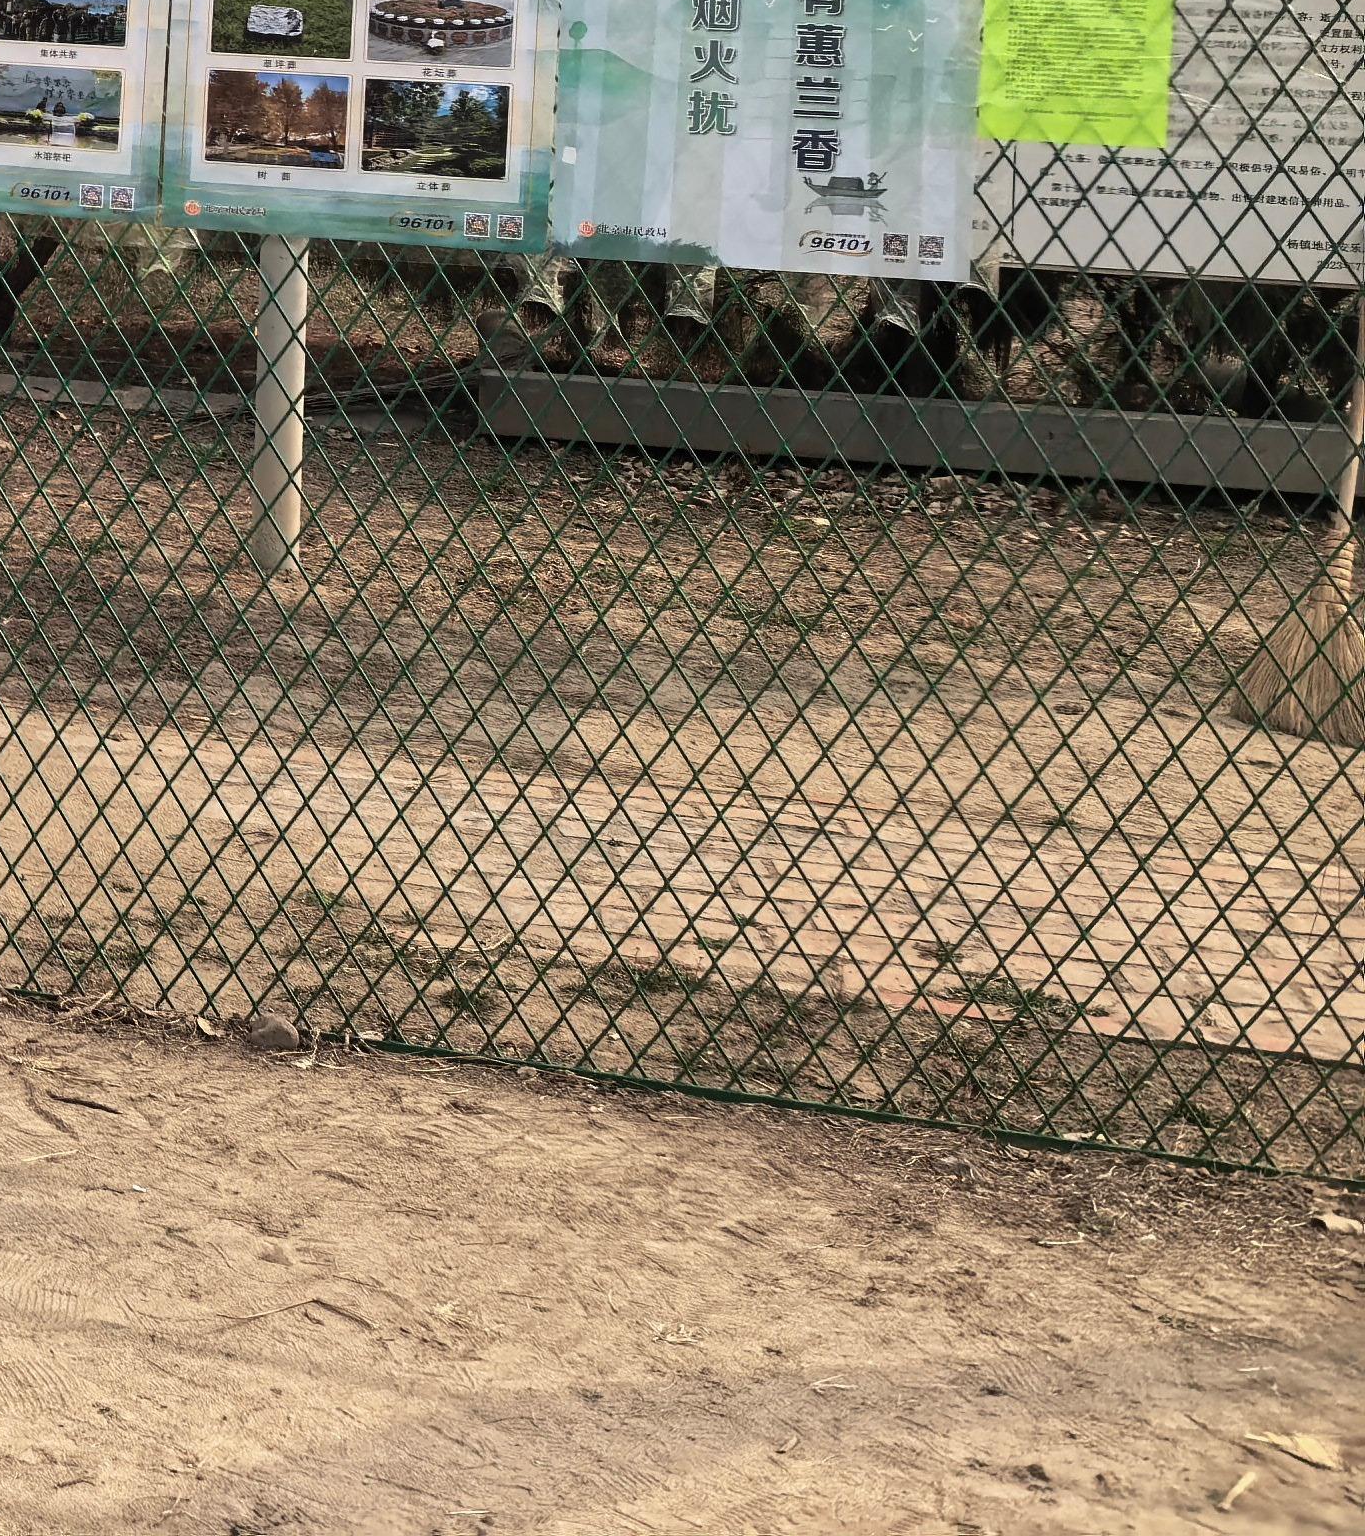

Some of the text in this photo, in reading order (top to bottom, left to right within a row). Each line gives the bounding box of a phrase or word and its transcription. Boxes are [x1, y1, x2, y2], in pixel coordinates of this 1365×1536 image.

[19, 185, 71, 201] 96101
[397, 216, 455, 231] 96101
[809, 235, 872, 252] 96101
